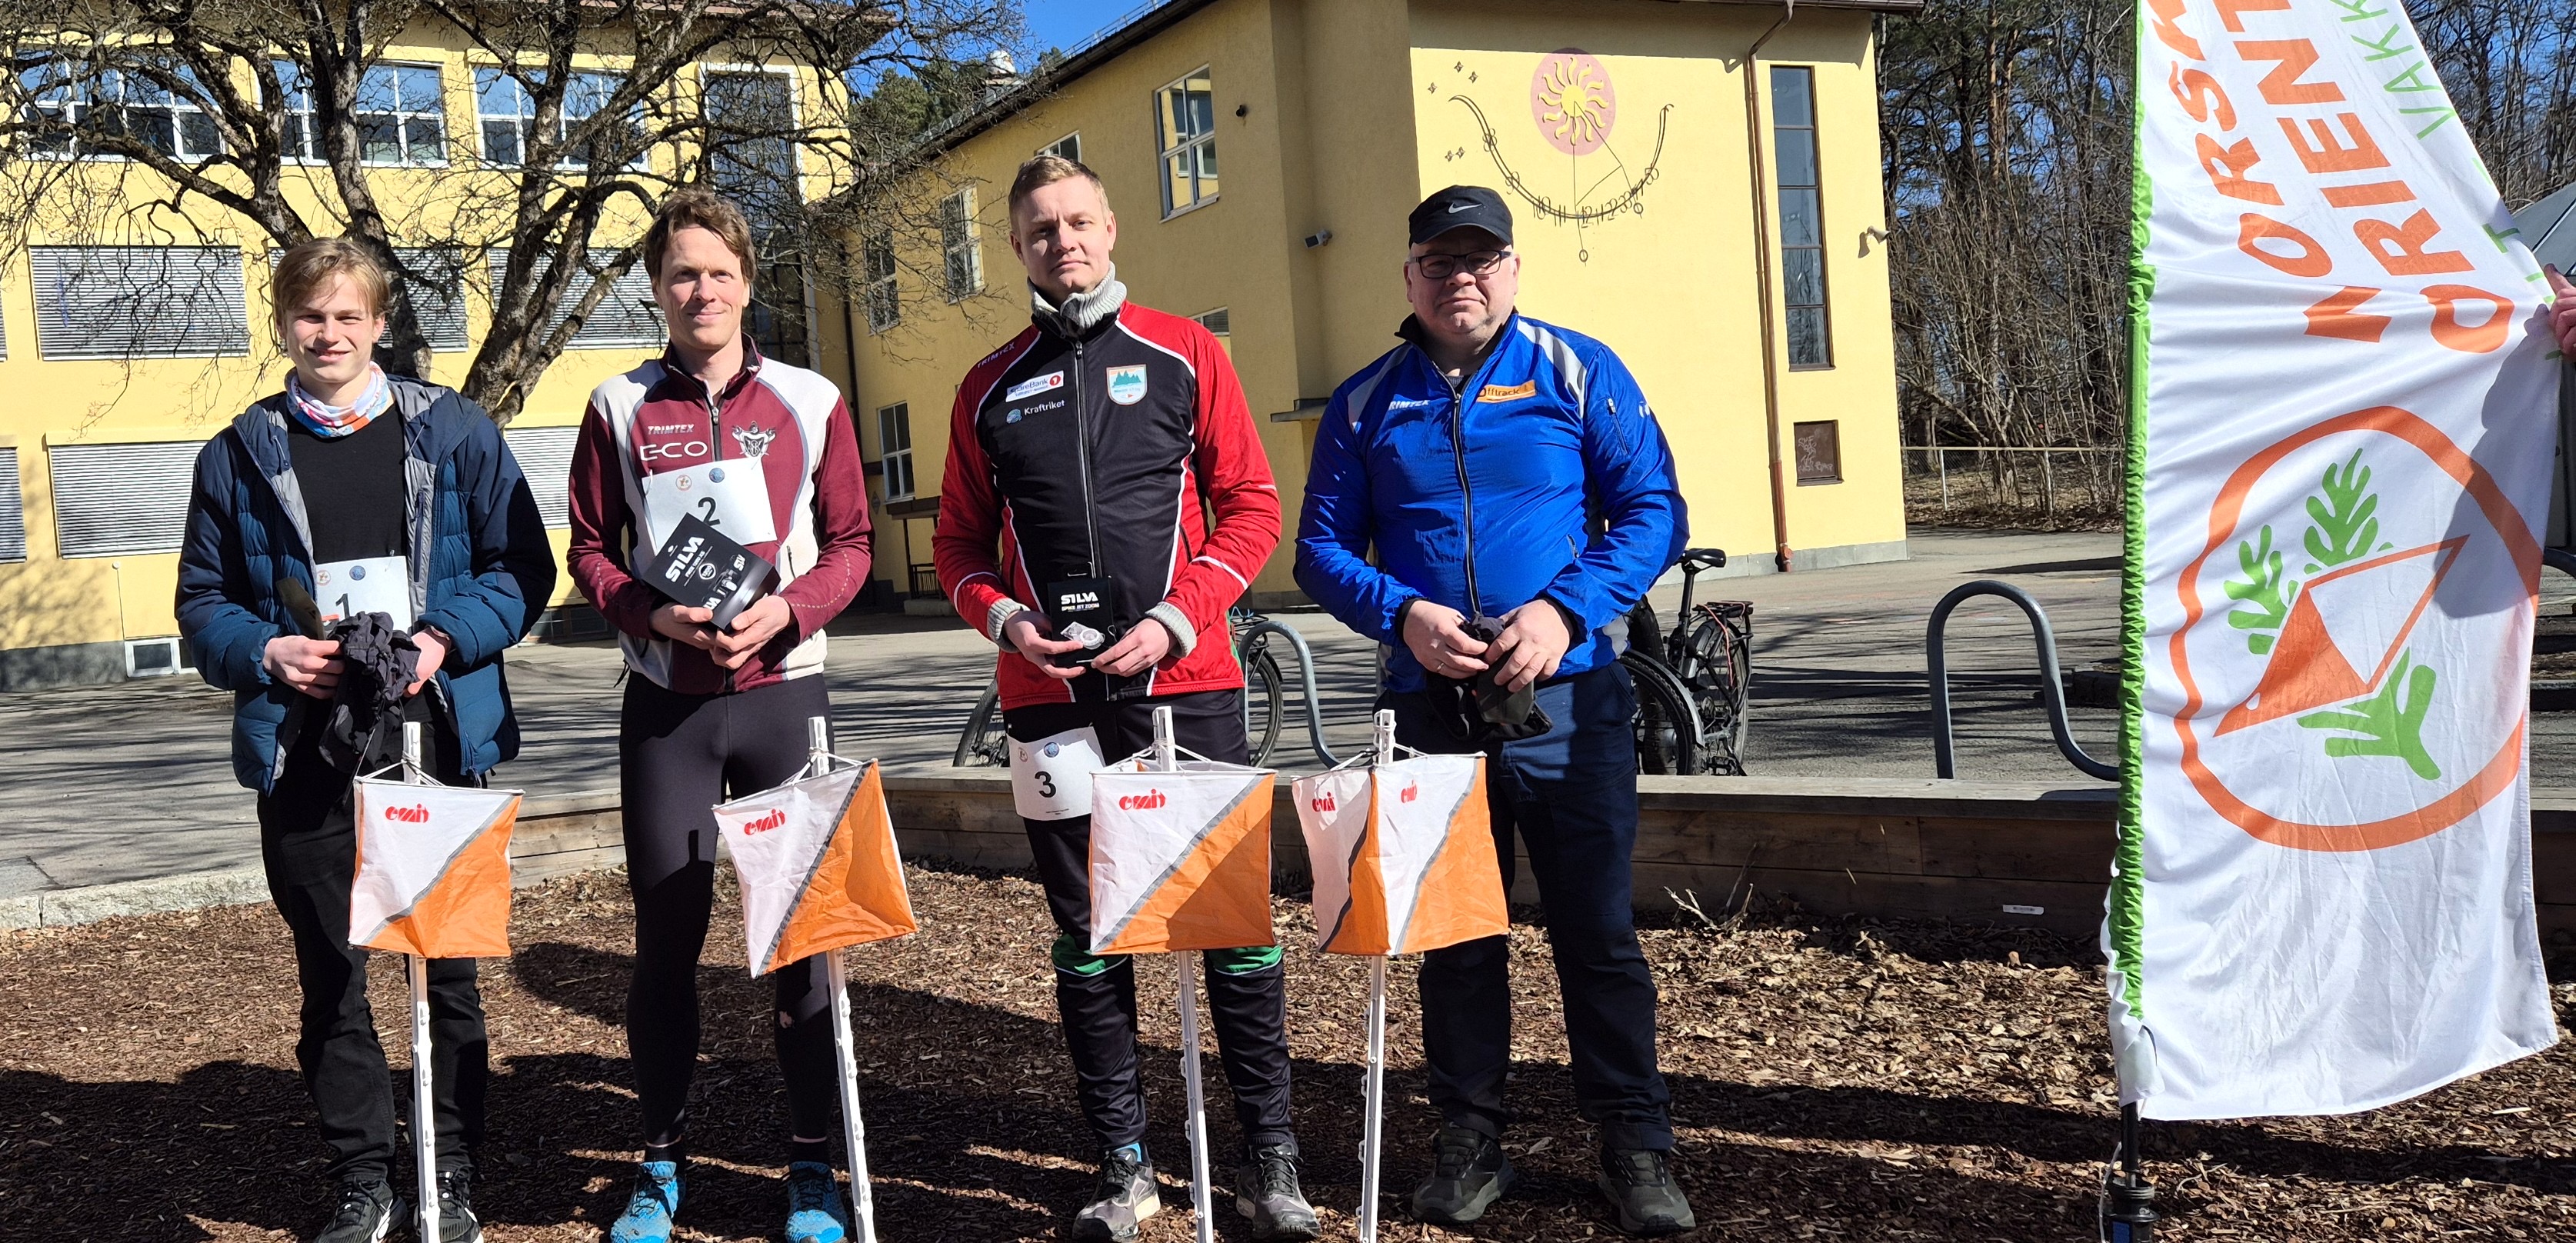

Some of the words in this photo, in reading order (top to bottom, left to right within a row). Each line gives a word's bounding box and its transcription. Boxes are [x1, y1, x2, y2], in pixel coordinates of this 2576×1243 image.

[1024, 399, 1065, 415] Kraftriket
[1388, 399, 1430, 411] RIMTEX
[648, 424, 695, 435] TRIMTEX
[698, 496, 721, 527] 2
[665, 536, 705, 582] SILVA
[335, 592, 350, 619] 1
[703, 597, 721, 611] LVA
[1061, 592, 1098, 605] SILVA
[1035, 771, 1056, 798] 3
[1311, 791, 1336, 812] emi
